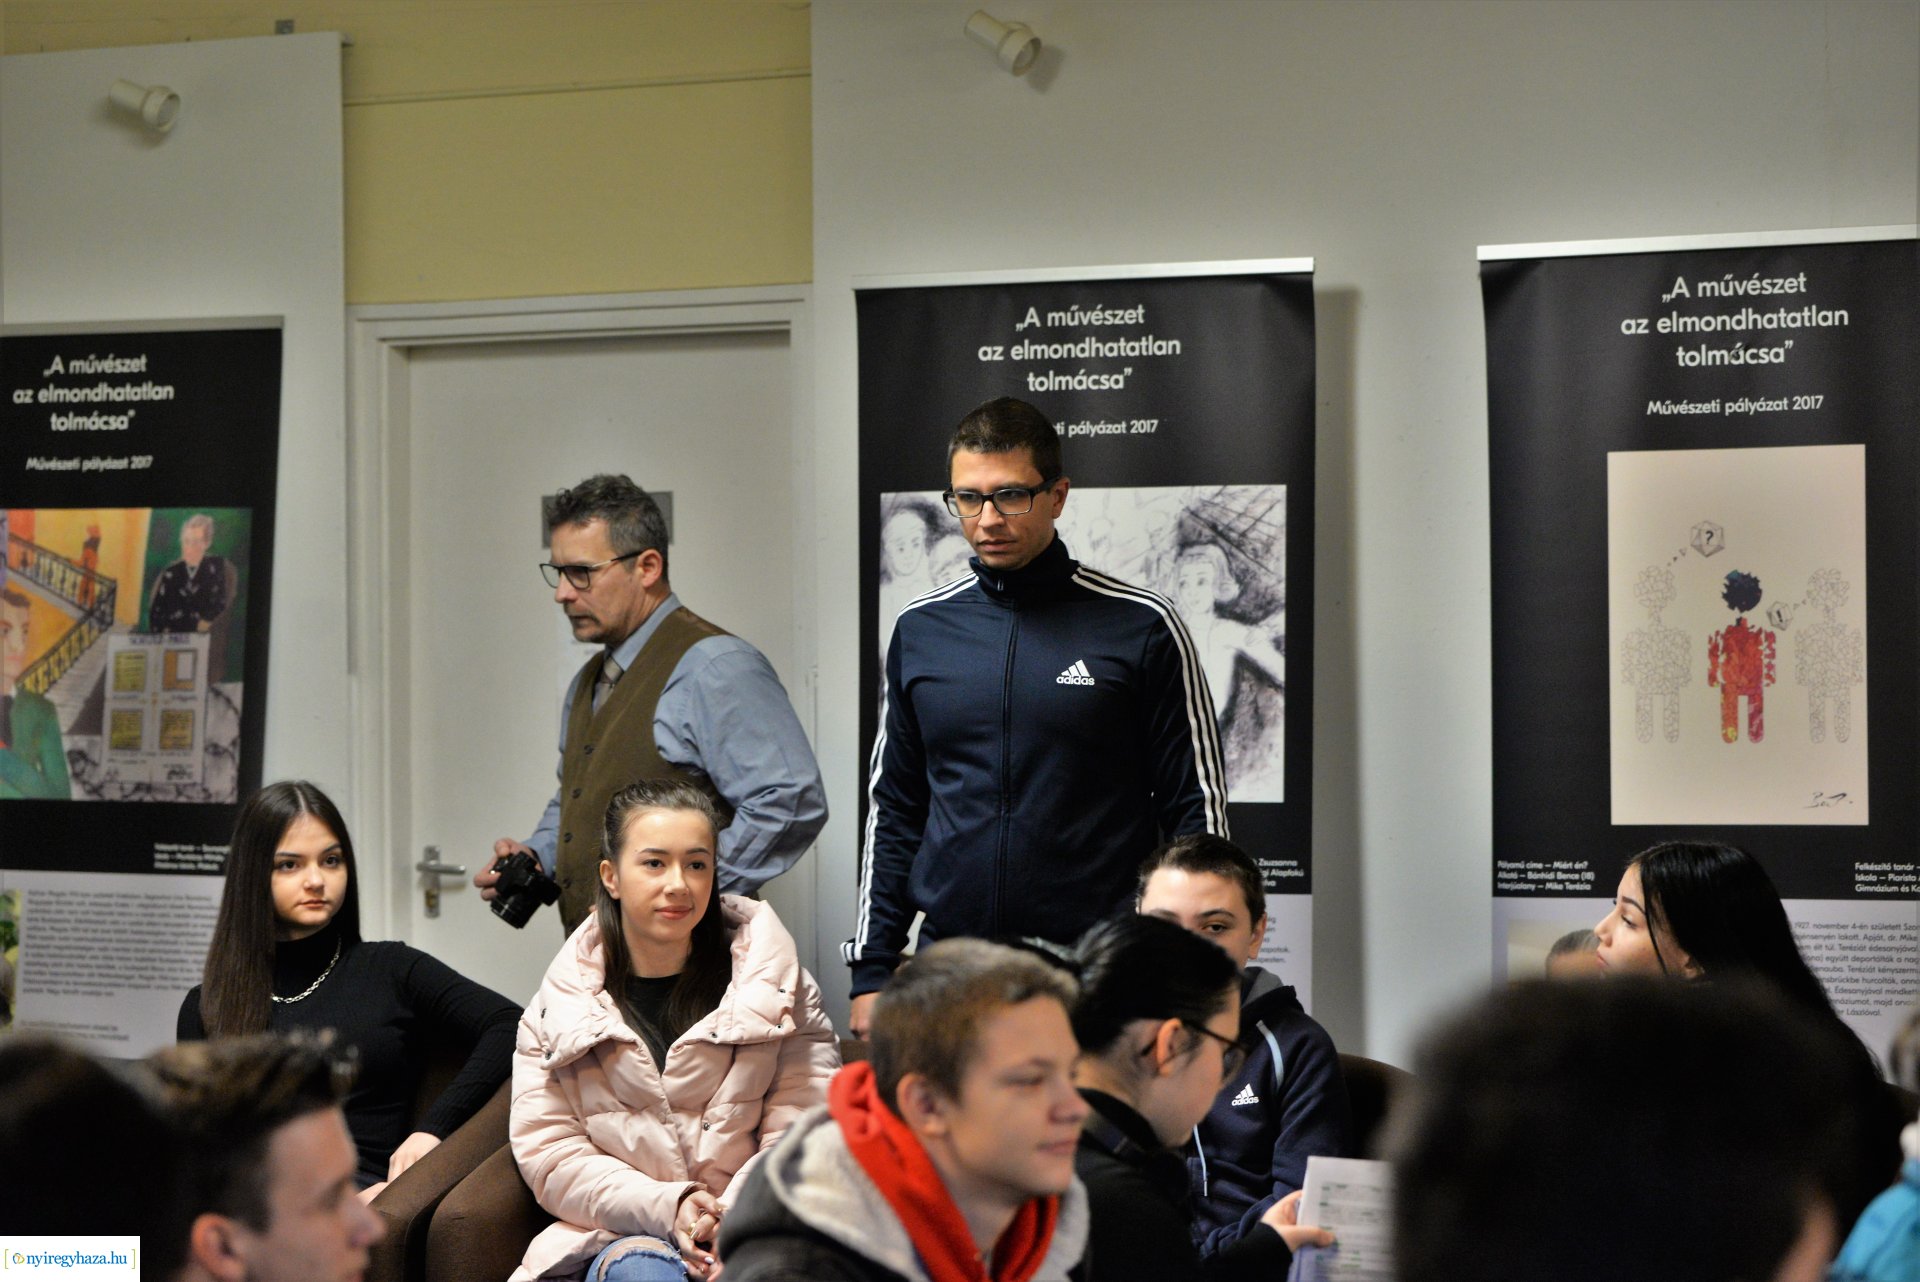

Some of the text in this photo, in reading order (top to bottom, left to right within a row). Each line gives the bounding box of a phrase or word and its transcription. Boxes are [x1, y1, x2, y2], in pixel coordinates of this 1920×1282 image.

[1662, 272, 1807, 303] „A művészet
[1015, 304, 1145, 332] „A művészet
[1621, 305, 1849, 335] az elmondhatatlan
[978, 335, 1181, 361] az elmondhatatlan
[1676, 340, 1794, 367] tolmácsa”
[1027, 367, 1133, 391] tolmácsa”
[13, 382, 174, 403] az elmondhatatlan
[1647, 395, 1824, 416] Művészeti pályázat 2017
[1068, 420, 1126, 437] pályázat
[1130, 419, 1159, 433] 2017
[1056, 675, 1095, 686] adidas
[1231, 1096, 1260, 1106] adidas
